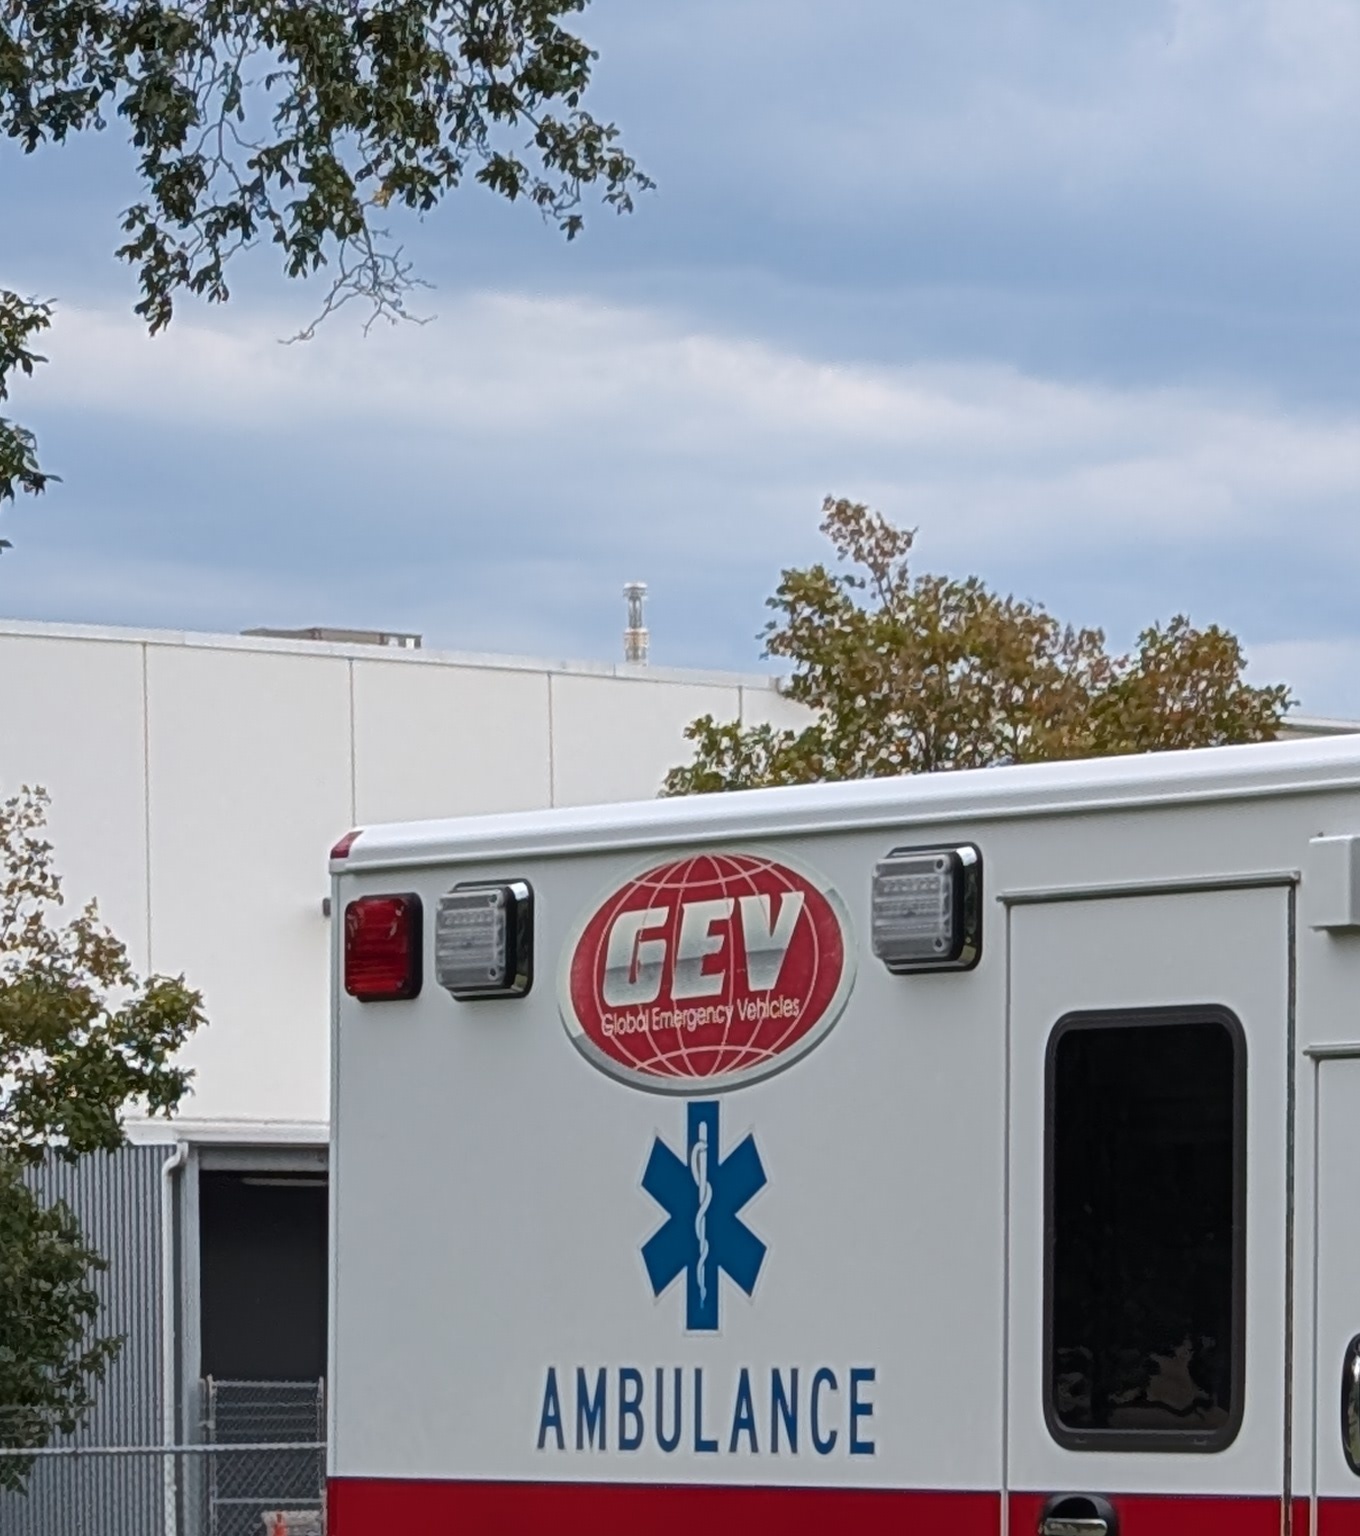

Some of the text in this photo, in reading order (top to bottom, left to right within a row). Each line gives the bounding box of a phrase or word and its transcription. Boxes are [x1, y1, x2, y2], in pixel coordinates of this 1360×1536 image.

[603, 891, 805, 1007] GEV
[602, 995, 801, 1036] Global Emergency Vehicles
[537, 1366, 876, 1455] AMBULANCE
